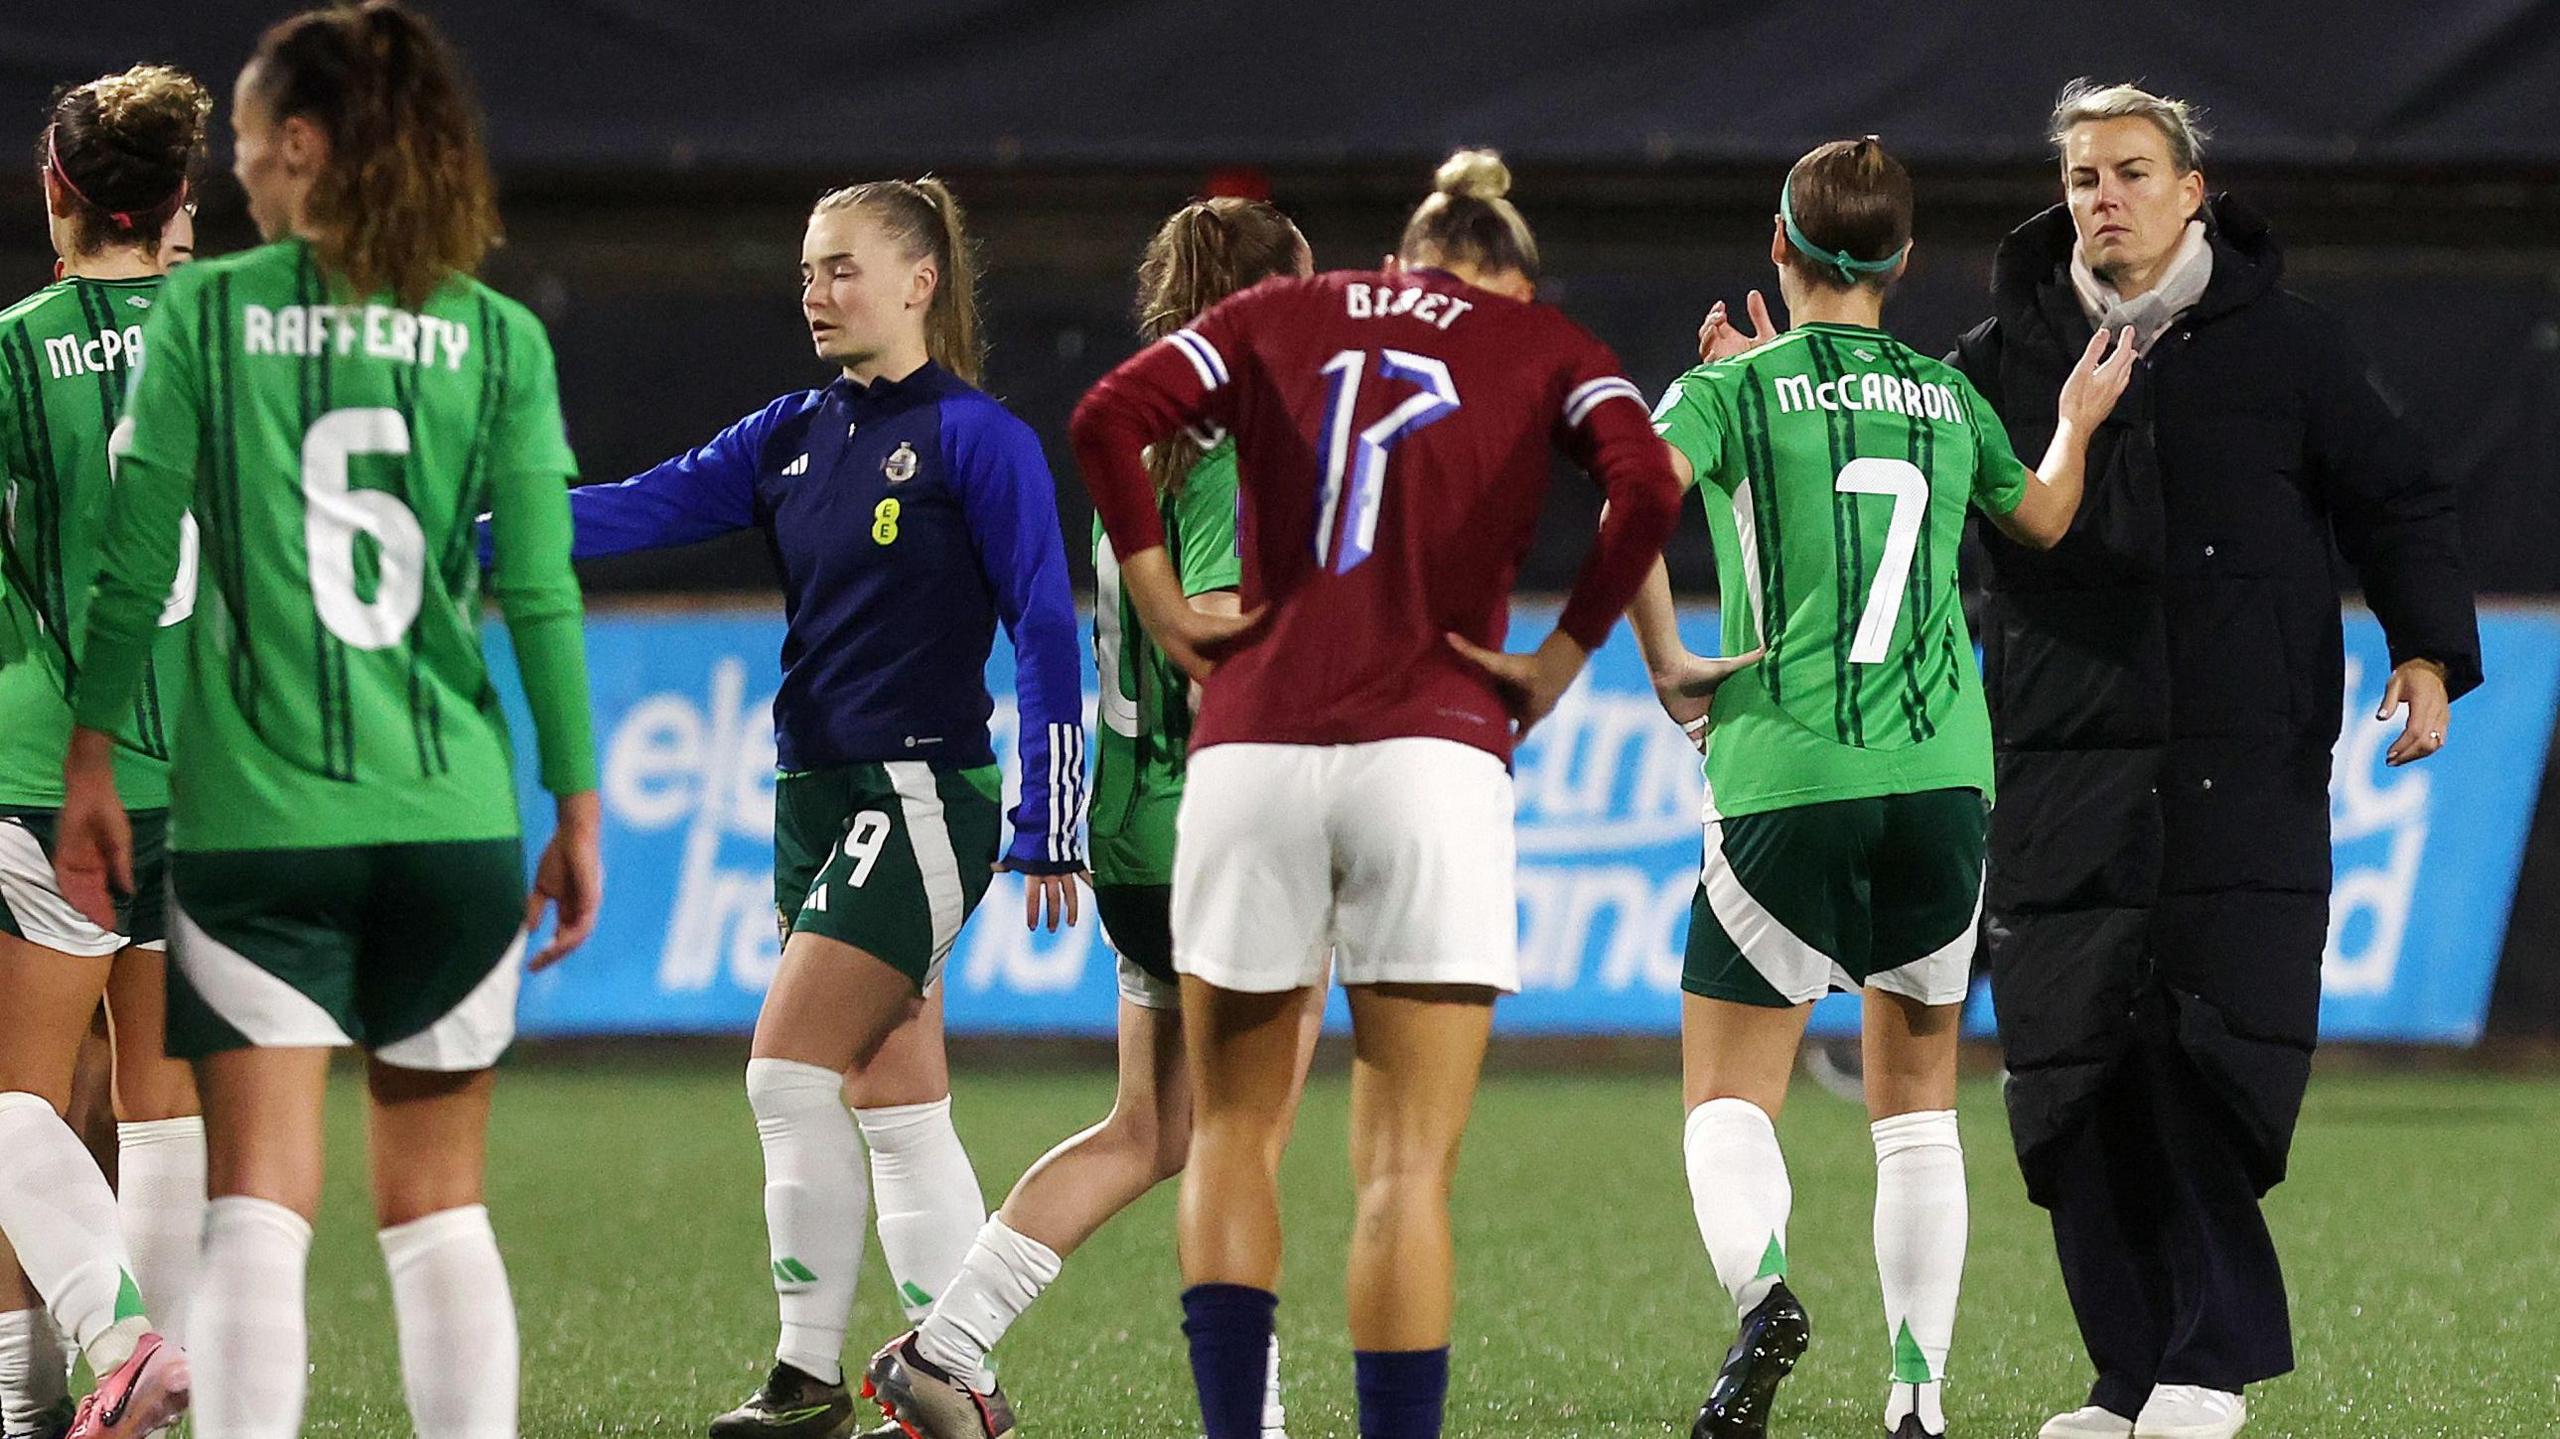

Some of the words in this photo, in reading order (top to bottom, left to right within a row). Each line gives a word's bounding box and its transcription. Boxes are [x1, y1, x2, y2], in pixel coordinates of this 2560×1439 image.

[44, 324, 144, 379] McPA
[244, 303, 470, 371] RAFFERTY
[1774, 372, 1963, 425] McCARRON
[1308, 349, 1463, 576] 17
[302, 407, 426, 650] 6
[1835, 457, 1930, 664] 7
[813, 809, 892, 888] 9
